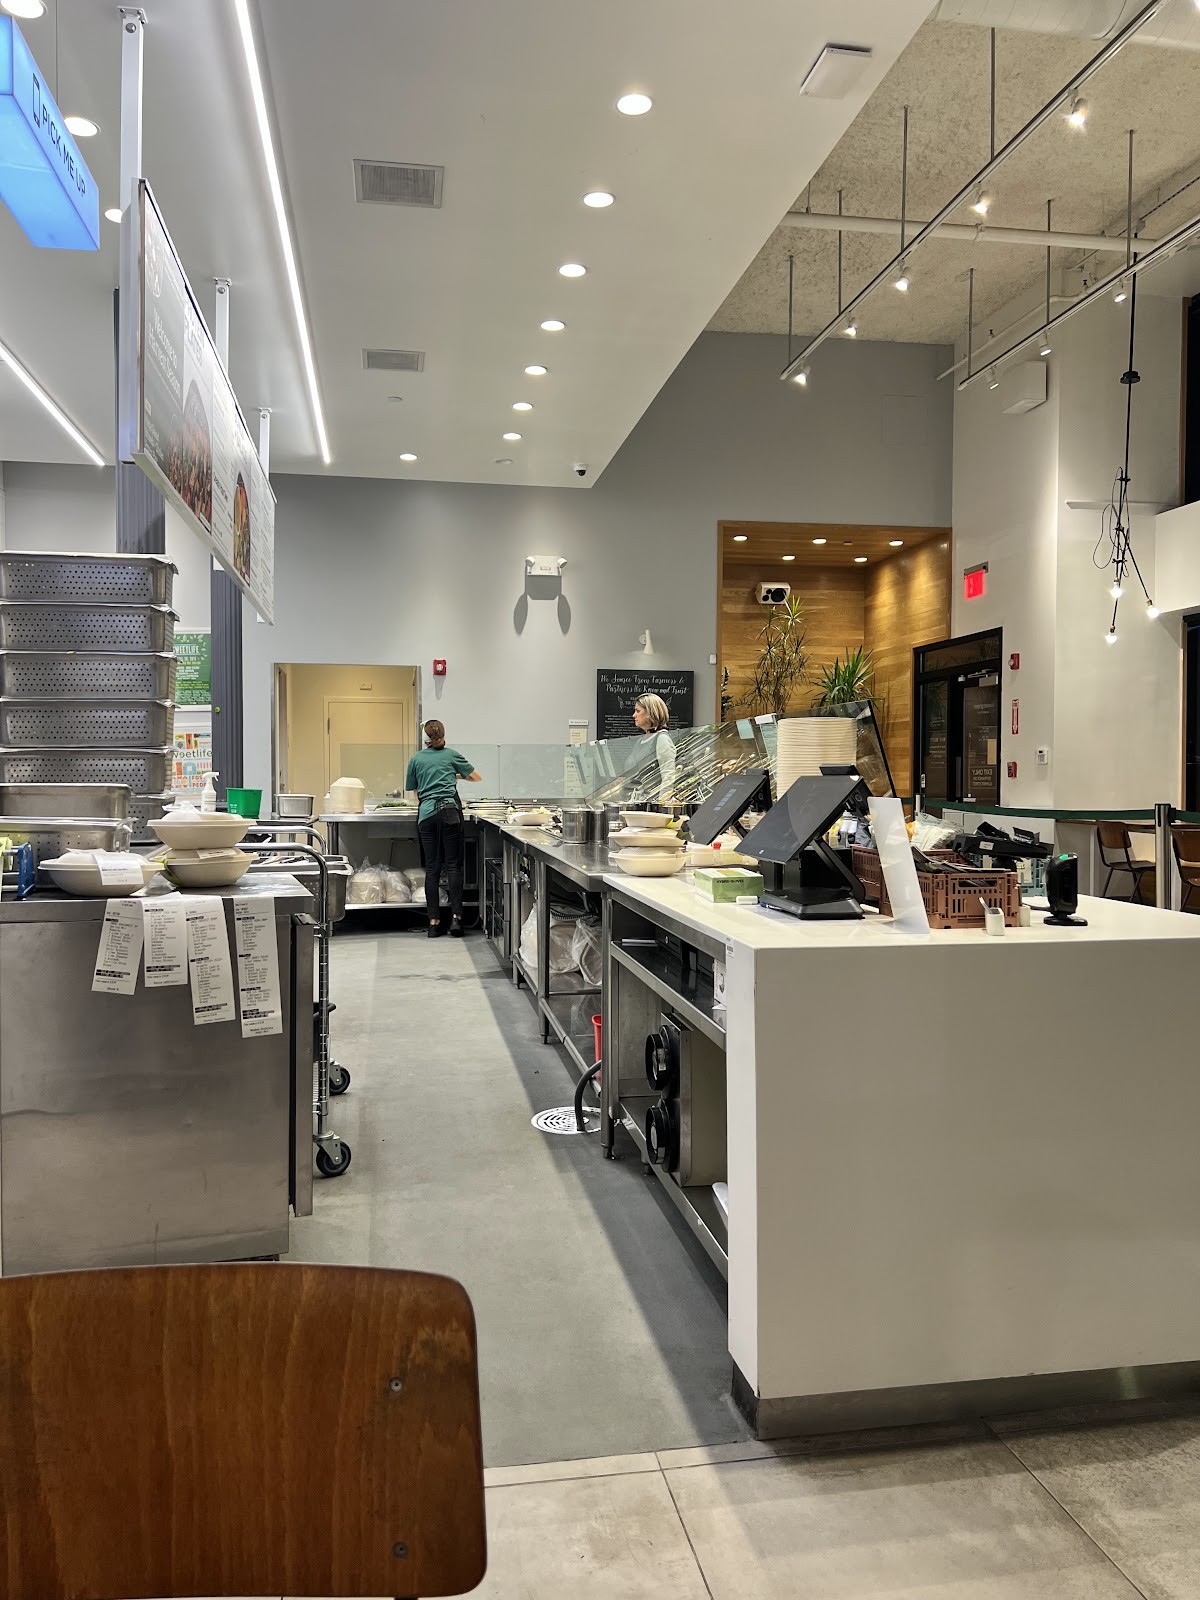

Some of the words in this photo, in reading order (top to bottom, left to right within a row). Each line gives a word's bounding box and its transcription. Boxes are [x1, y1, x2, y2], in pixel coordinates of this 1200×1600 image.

[42, 103, 62, 157] PICK
[63, 144, 75, 180] ME
[75, 169, 86, 197] UP
[173, 749, 212, 758] weetlife
